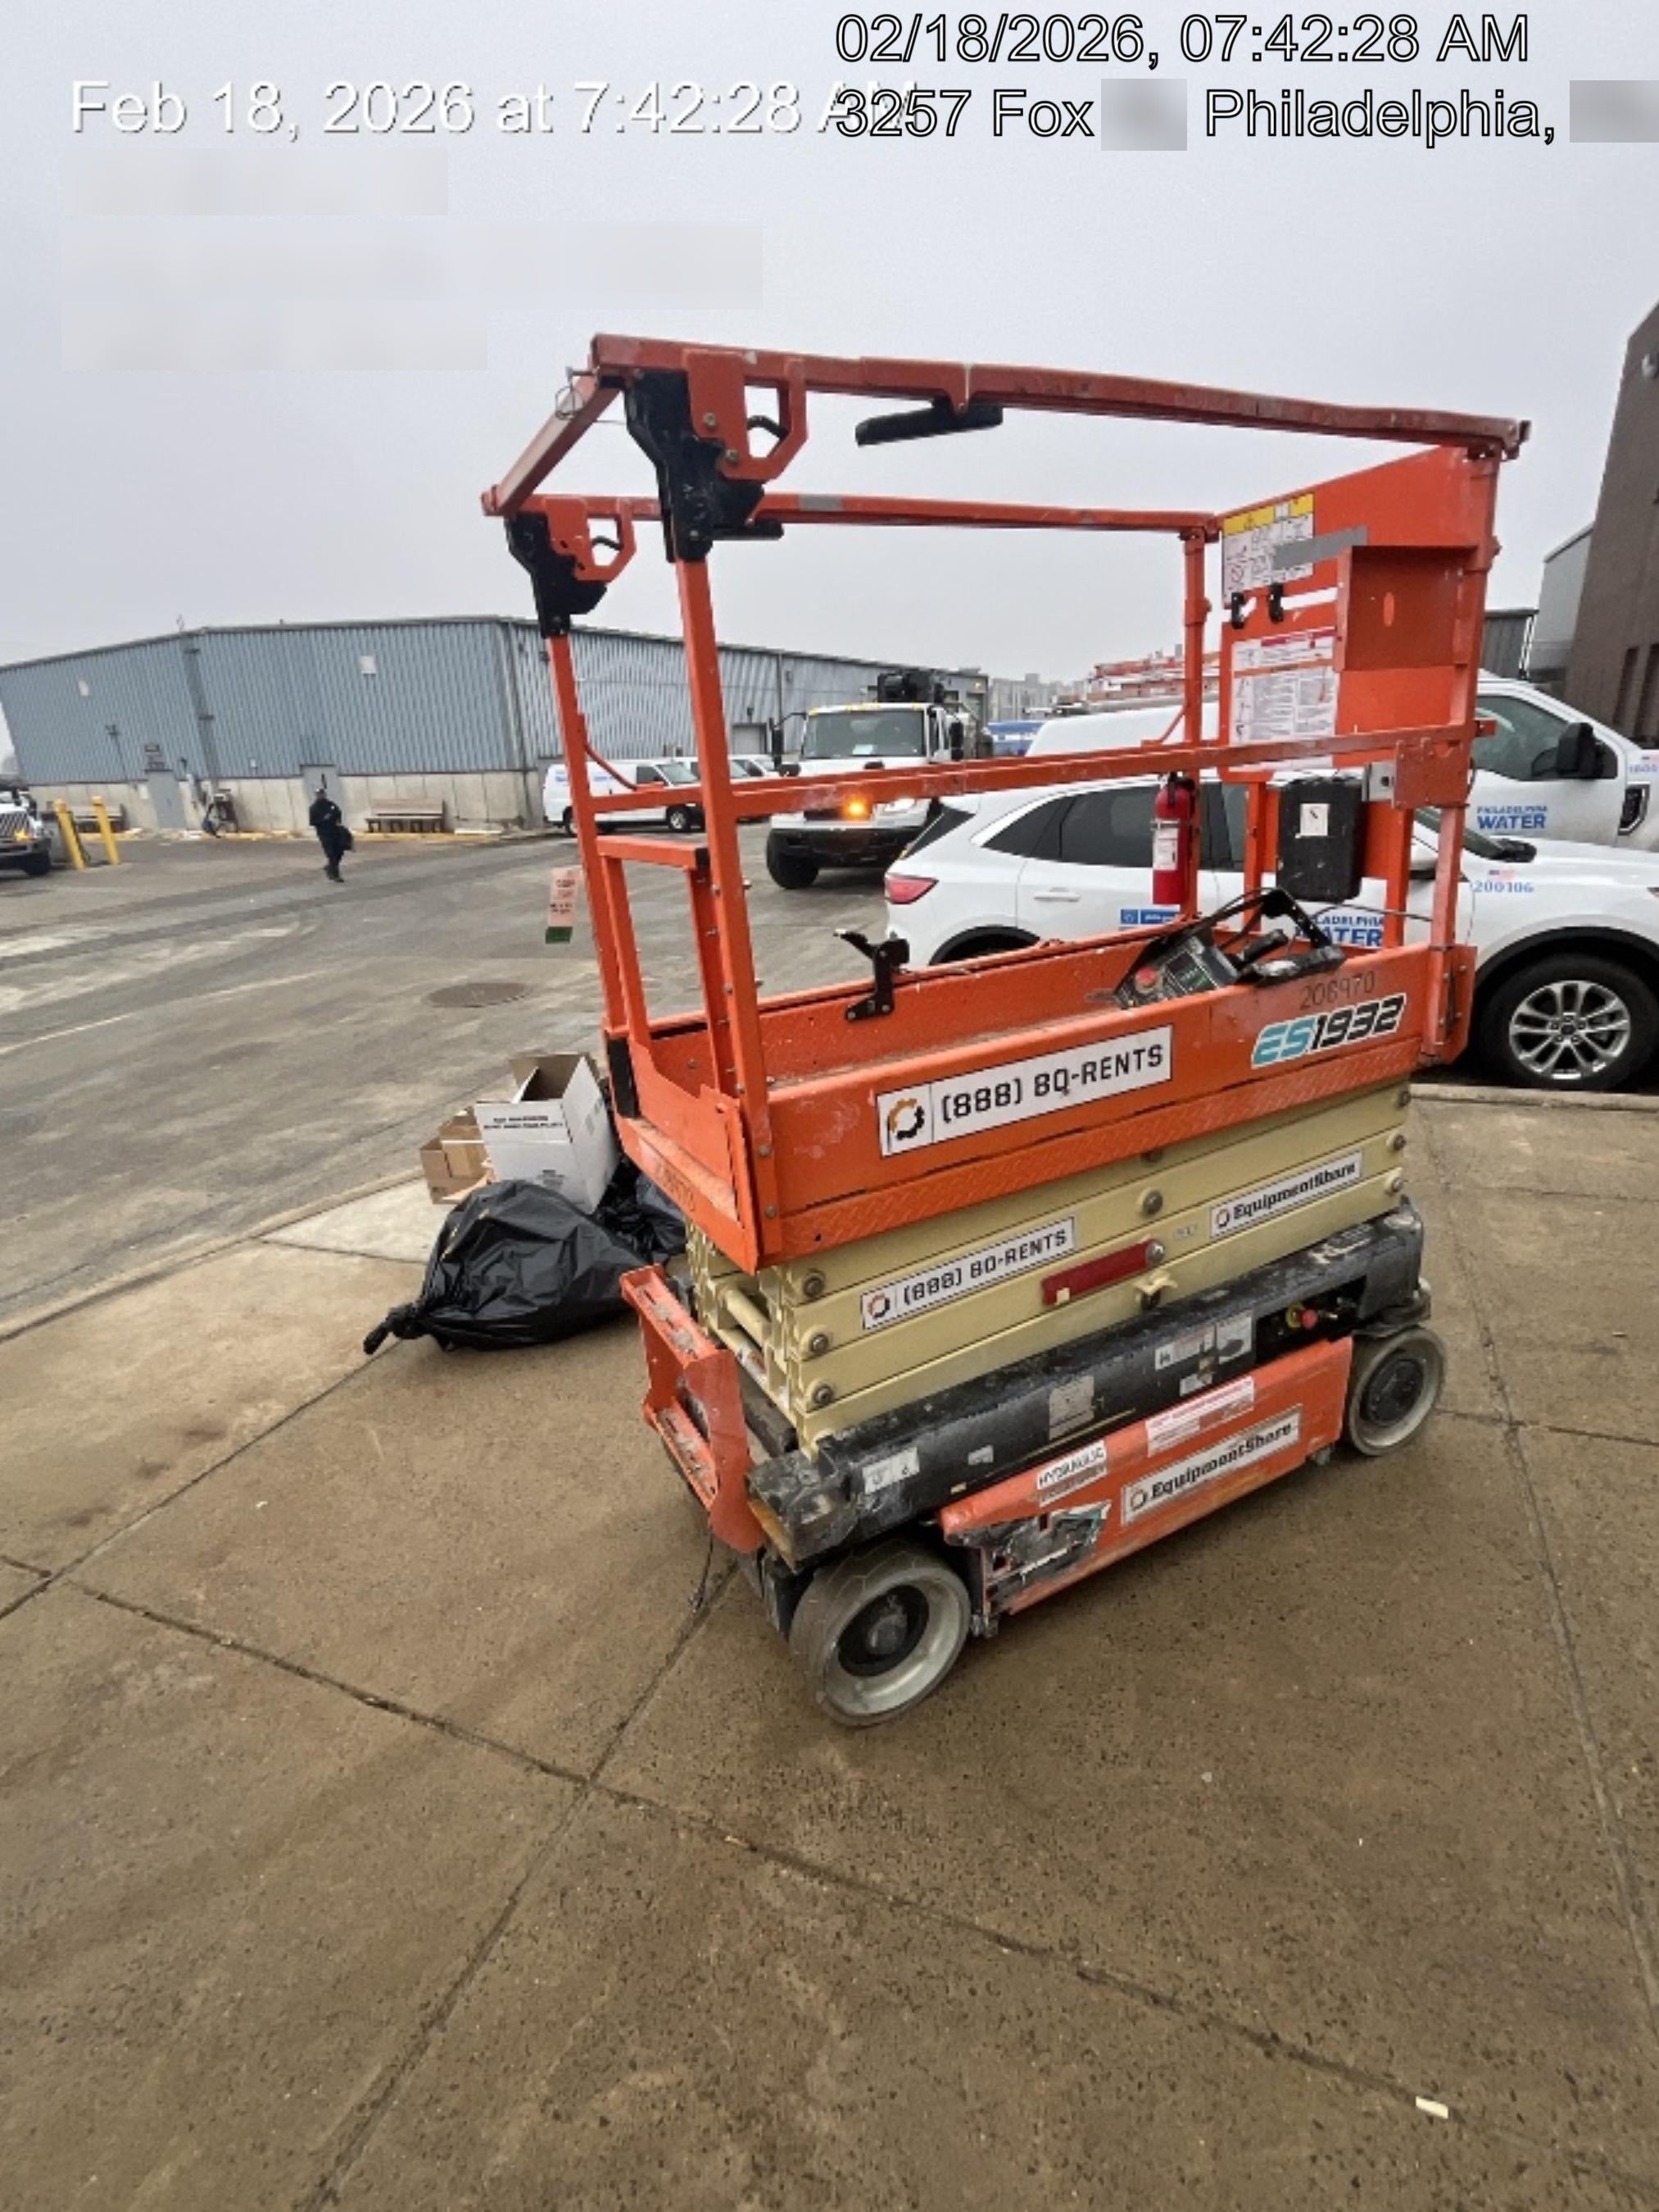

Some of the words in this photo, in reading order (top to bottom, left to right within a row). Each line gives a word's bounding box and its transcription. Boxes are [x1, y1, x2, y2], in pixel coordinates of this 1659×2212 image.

[1477, 805, 1547, 814] PHILADELPHIA
[1477, 814, 1546, 829] WATER
[1473, 881, 1534, 893] 200106
[1253, 994, 1405, 1067] ES1932
[941, 1078, 1023, 1124] (888)
[1034, 1044, 1164, 1097] 8Q-RENTS
[1233, 1163, 1356, 1219] EquipmentShare
[904, 1267, 962, 1305] (888)
[1151, 1422, 1292, 1498] EquipmentShare
